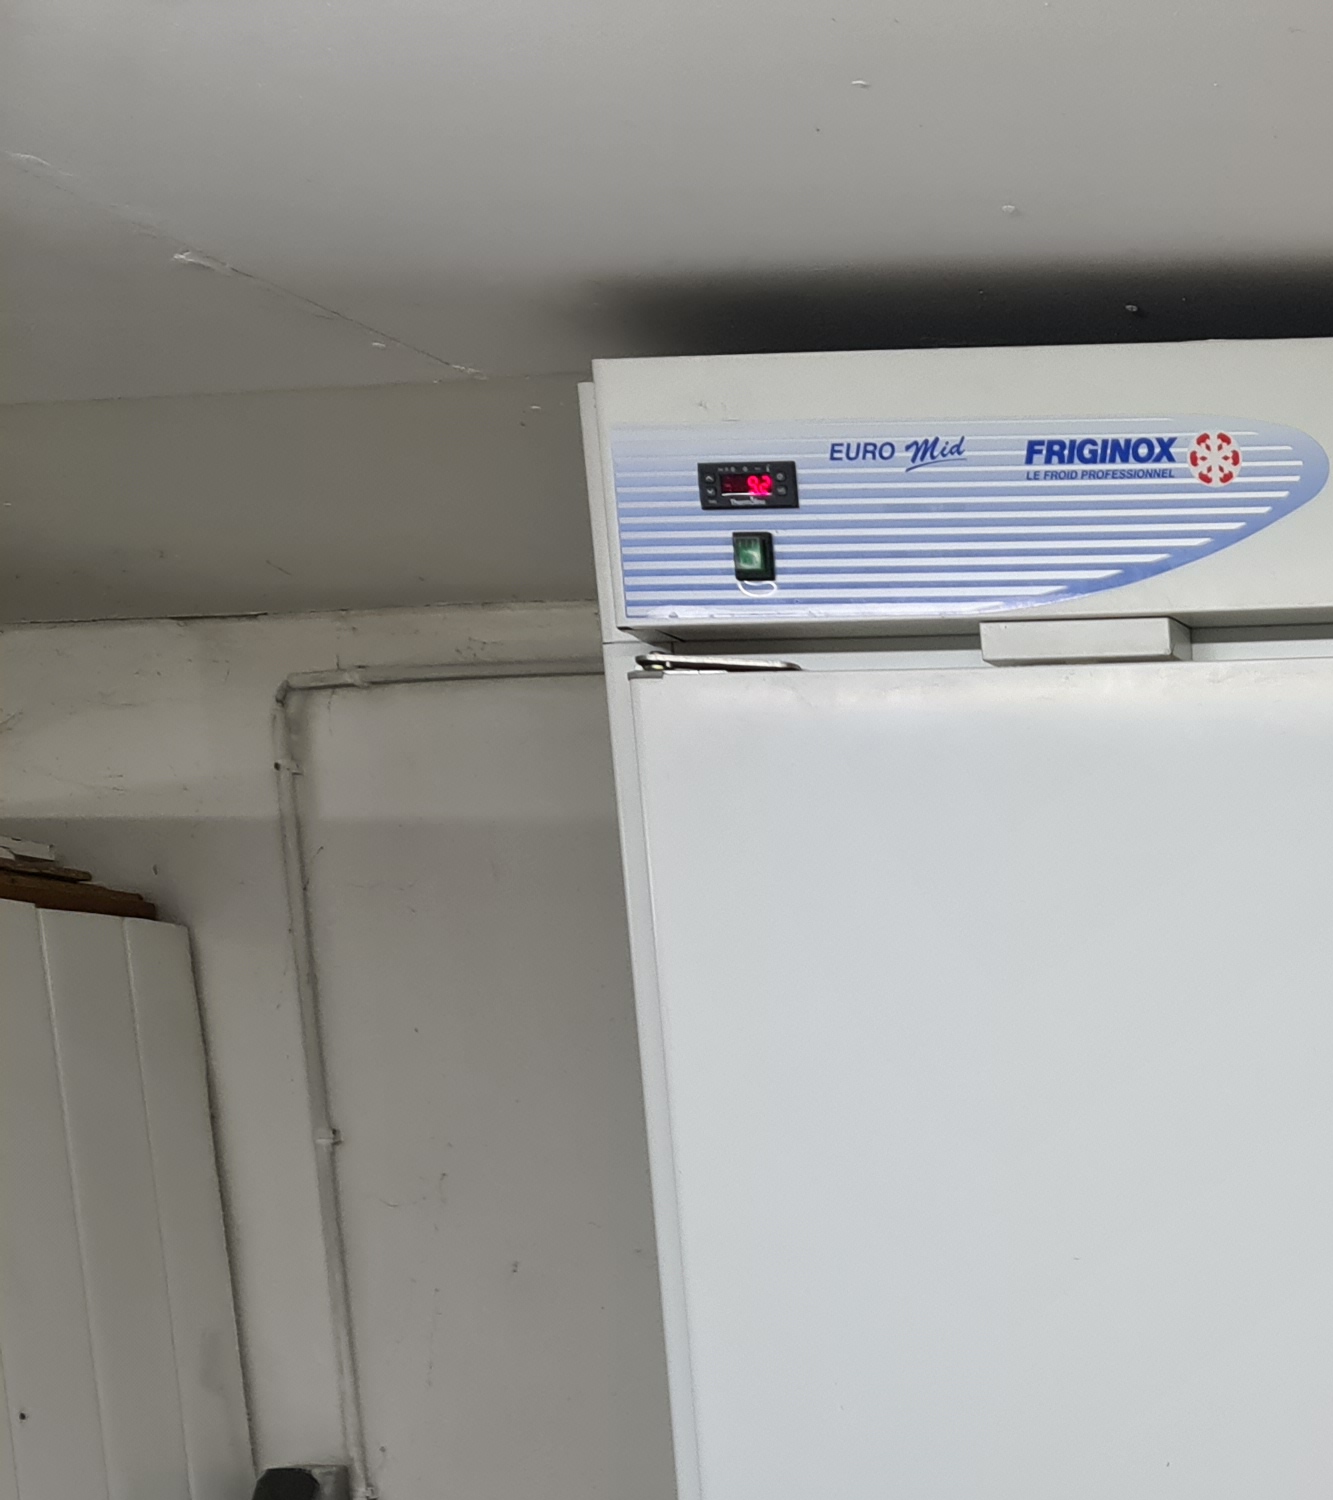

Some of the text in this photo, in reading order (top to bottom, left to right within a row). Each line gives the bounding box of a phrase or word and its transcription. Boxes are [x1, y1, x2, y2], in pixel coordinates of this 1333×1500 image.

[829, 436, 966, 465] EURO Mid
[1024, 437, 1178, 465] FRIGINOX
[1026, 468, 1174, 481] LE FROID PROFESSIONNEL
